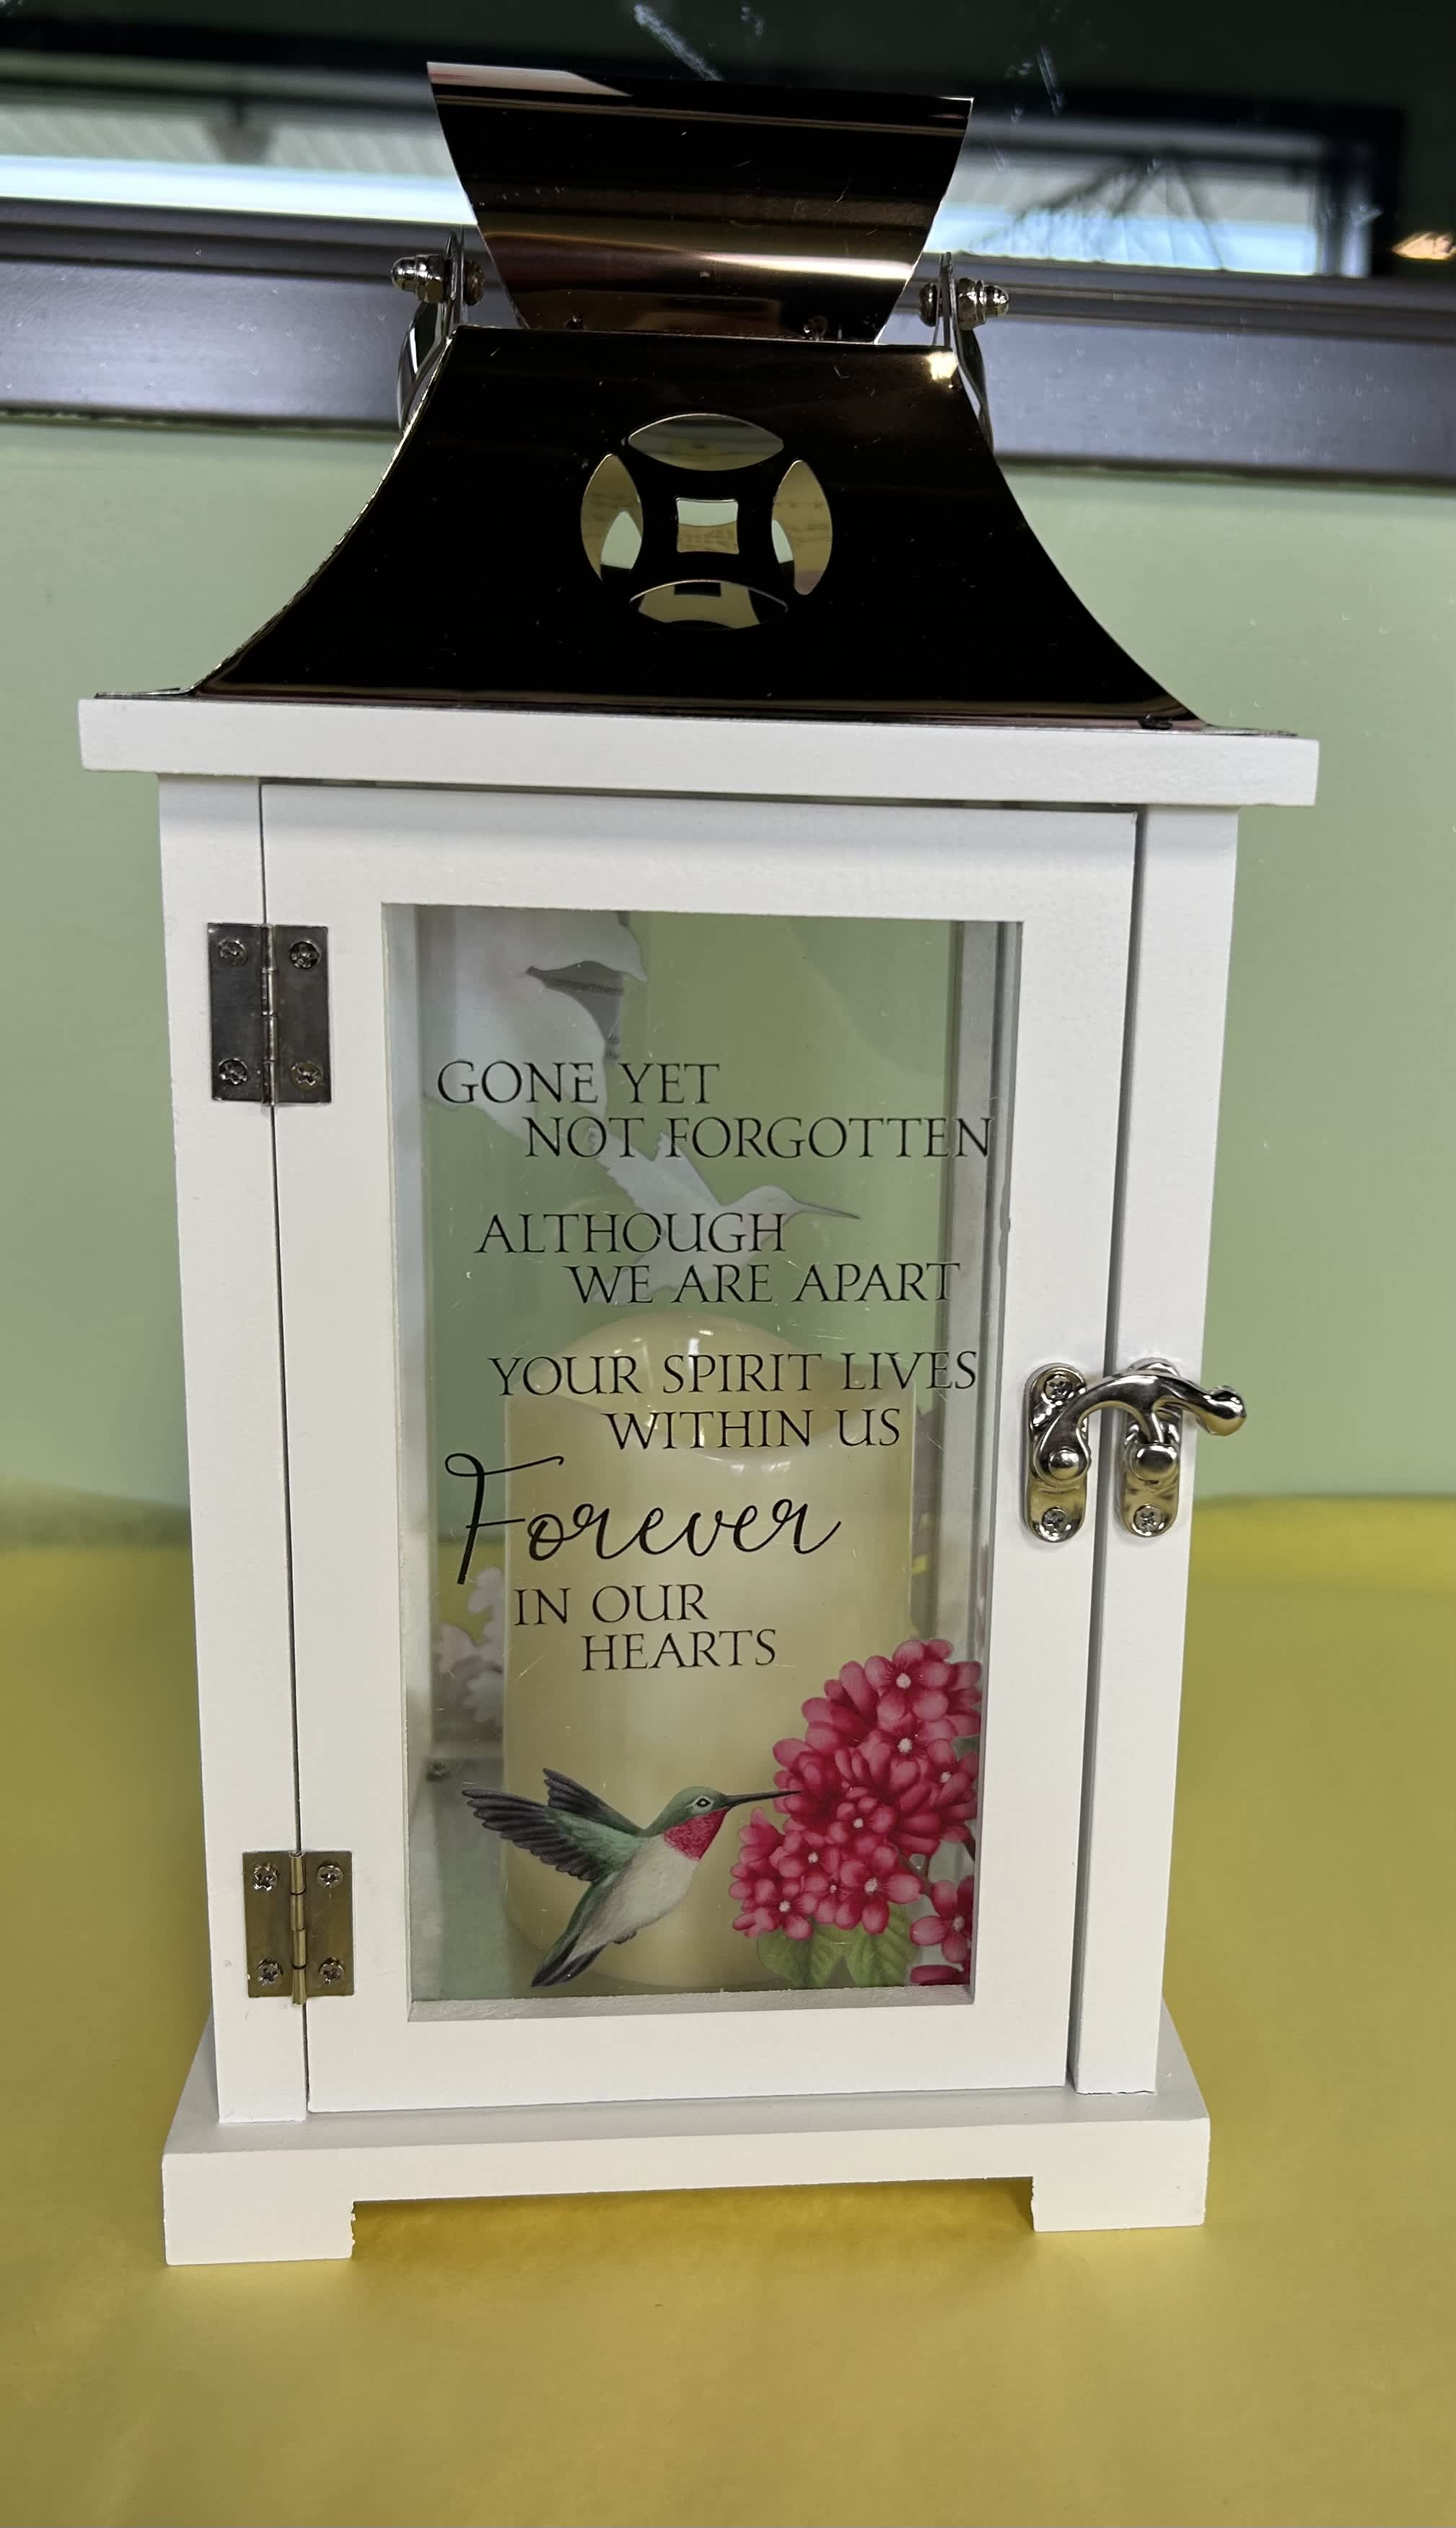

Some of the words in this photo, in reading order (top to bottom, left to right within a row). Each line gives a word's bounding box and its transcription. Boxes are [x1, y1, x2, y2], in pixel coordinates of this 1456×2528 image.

[437, 1060, 598, 1103] GONE
[621, 1062, 720, 1104] YET
[525, 1116, 644, 1158] NOT
[666, 1116, 992, 1158] FORGOTTEN
[474, 1212, 787, 1254] ALTHOUGH
[569, 1264, 650, 1304] WE
[671, 1264, 771, 1304] ARE
[792, 1262, 961, 1303] APART
[488, 1355, 641, 1397] YOUR
[662, 1352, 822, 1394] SPIRIT
[841, 1351, 978, 1391] LIVES
[600, 1409, 812, 1451] WITHIN
[836, 1408, 902, 1447] US
[444, 1452, 842, 1585] Forever
[514, 1588, 570, 1627] IN
[592, 1583, 709, 1623] OUR
[581, 1628, 778, 1672] HEARTS
